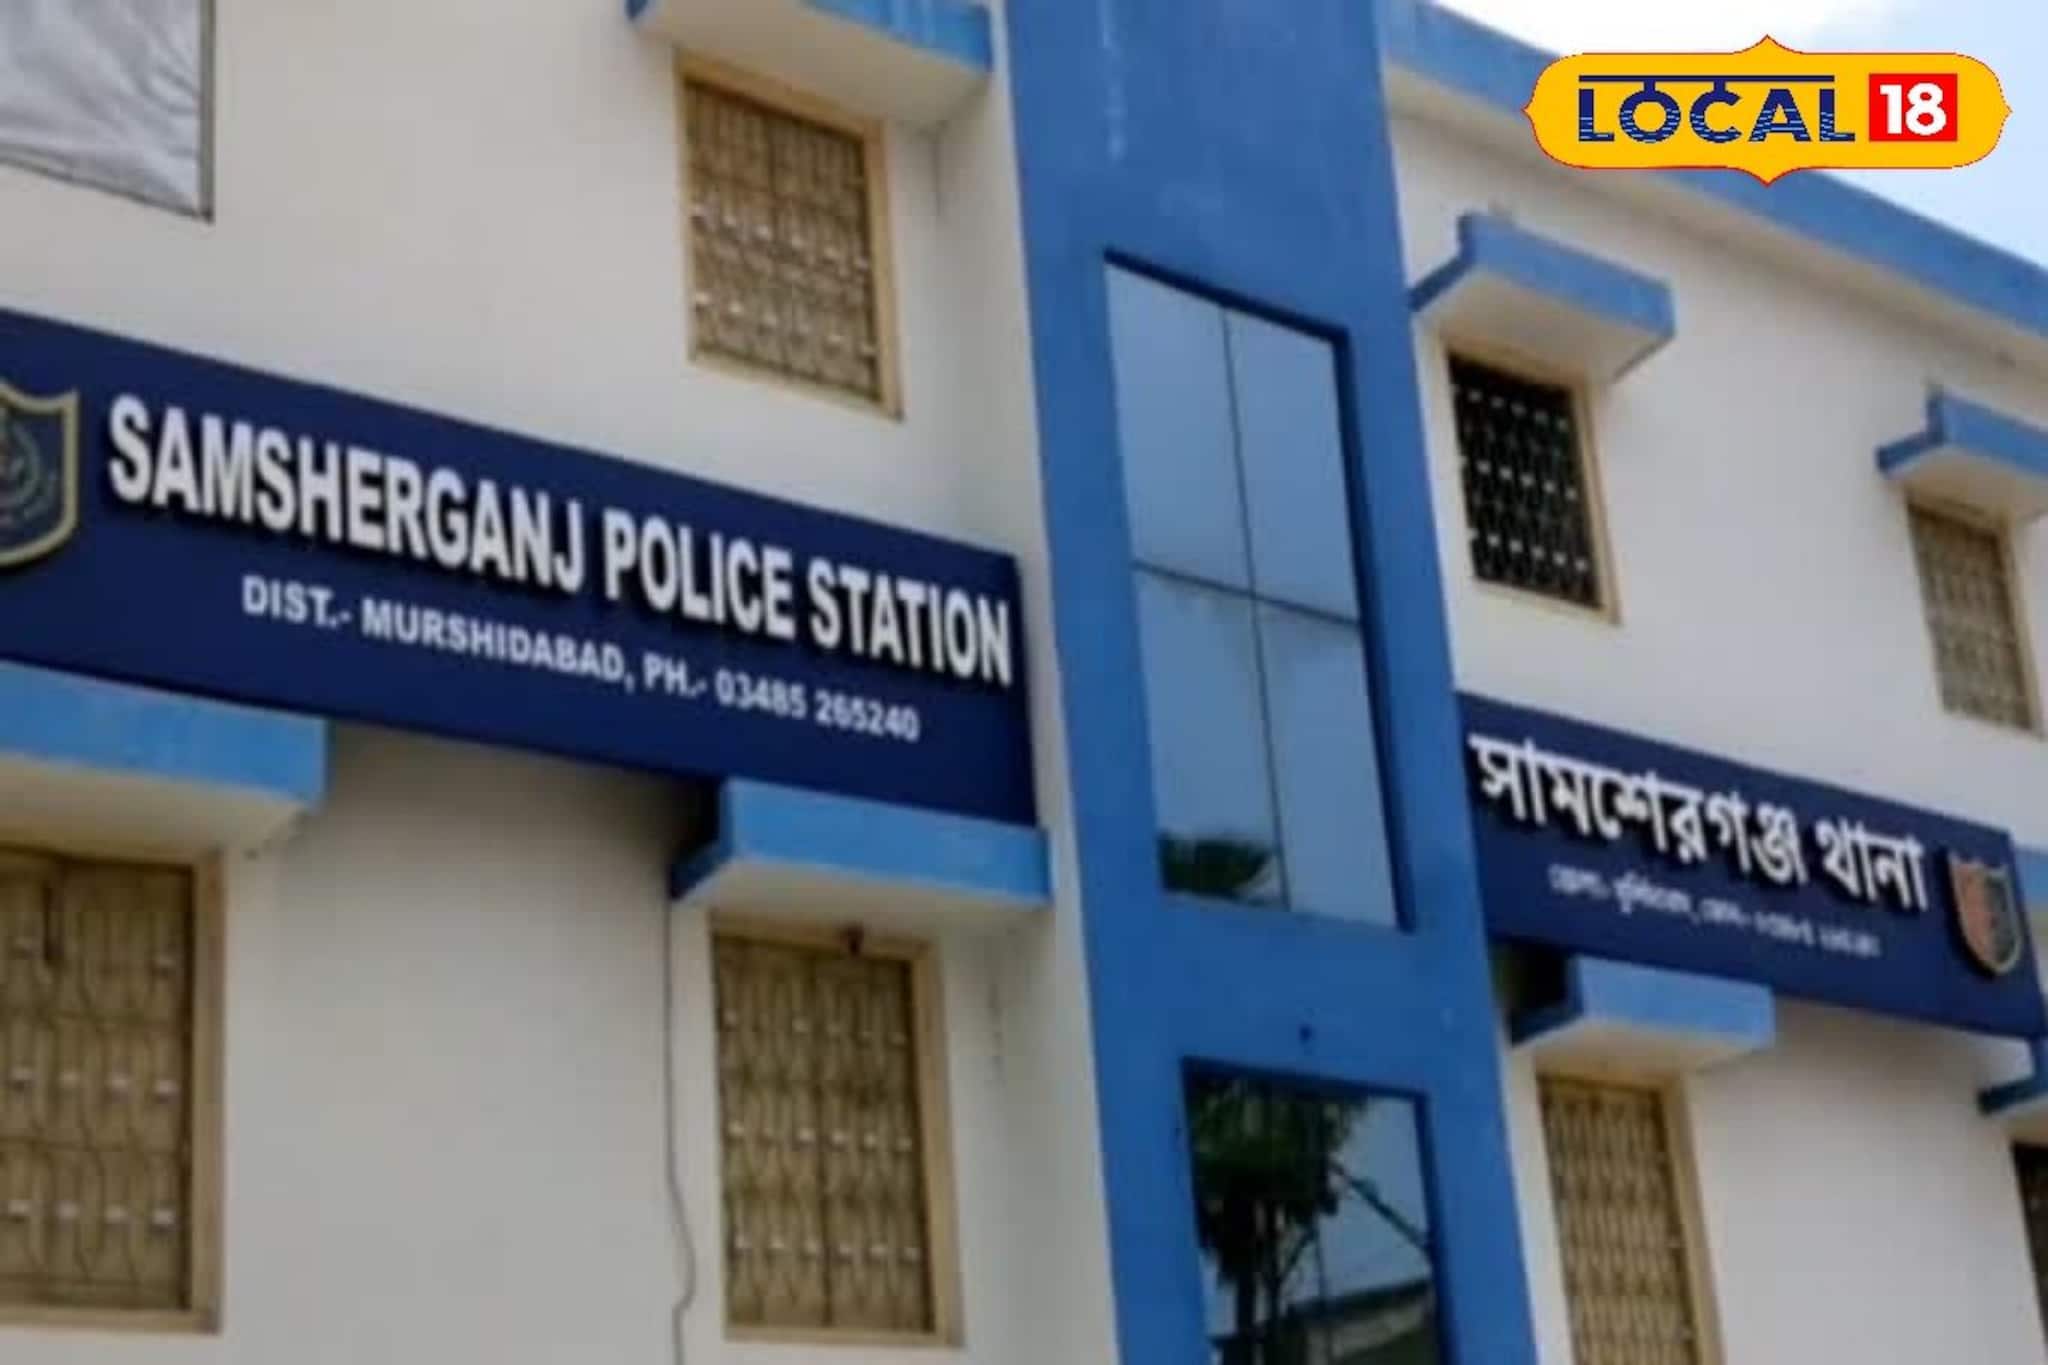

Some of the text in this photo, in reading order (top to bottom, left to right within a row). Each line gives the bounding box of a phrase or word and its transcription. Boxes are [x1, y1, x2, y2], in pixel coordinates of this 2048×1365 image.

[107, 393, 1012, 687] SAMSHERGANJ POLICE STATION
[361, 596, 634, 693] MURSHIDABAD,
[715, 669, 807, 719] 03485
[815, 691, 921, 743] 265240
[1468, 732, 1809, 885] সামশেরগঞ্জ
[1815, 816, 1928, 911] থানা
